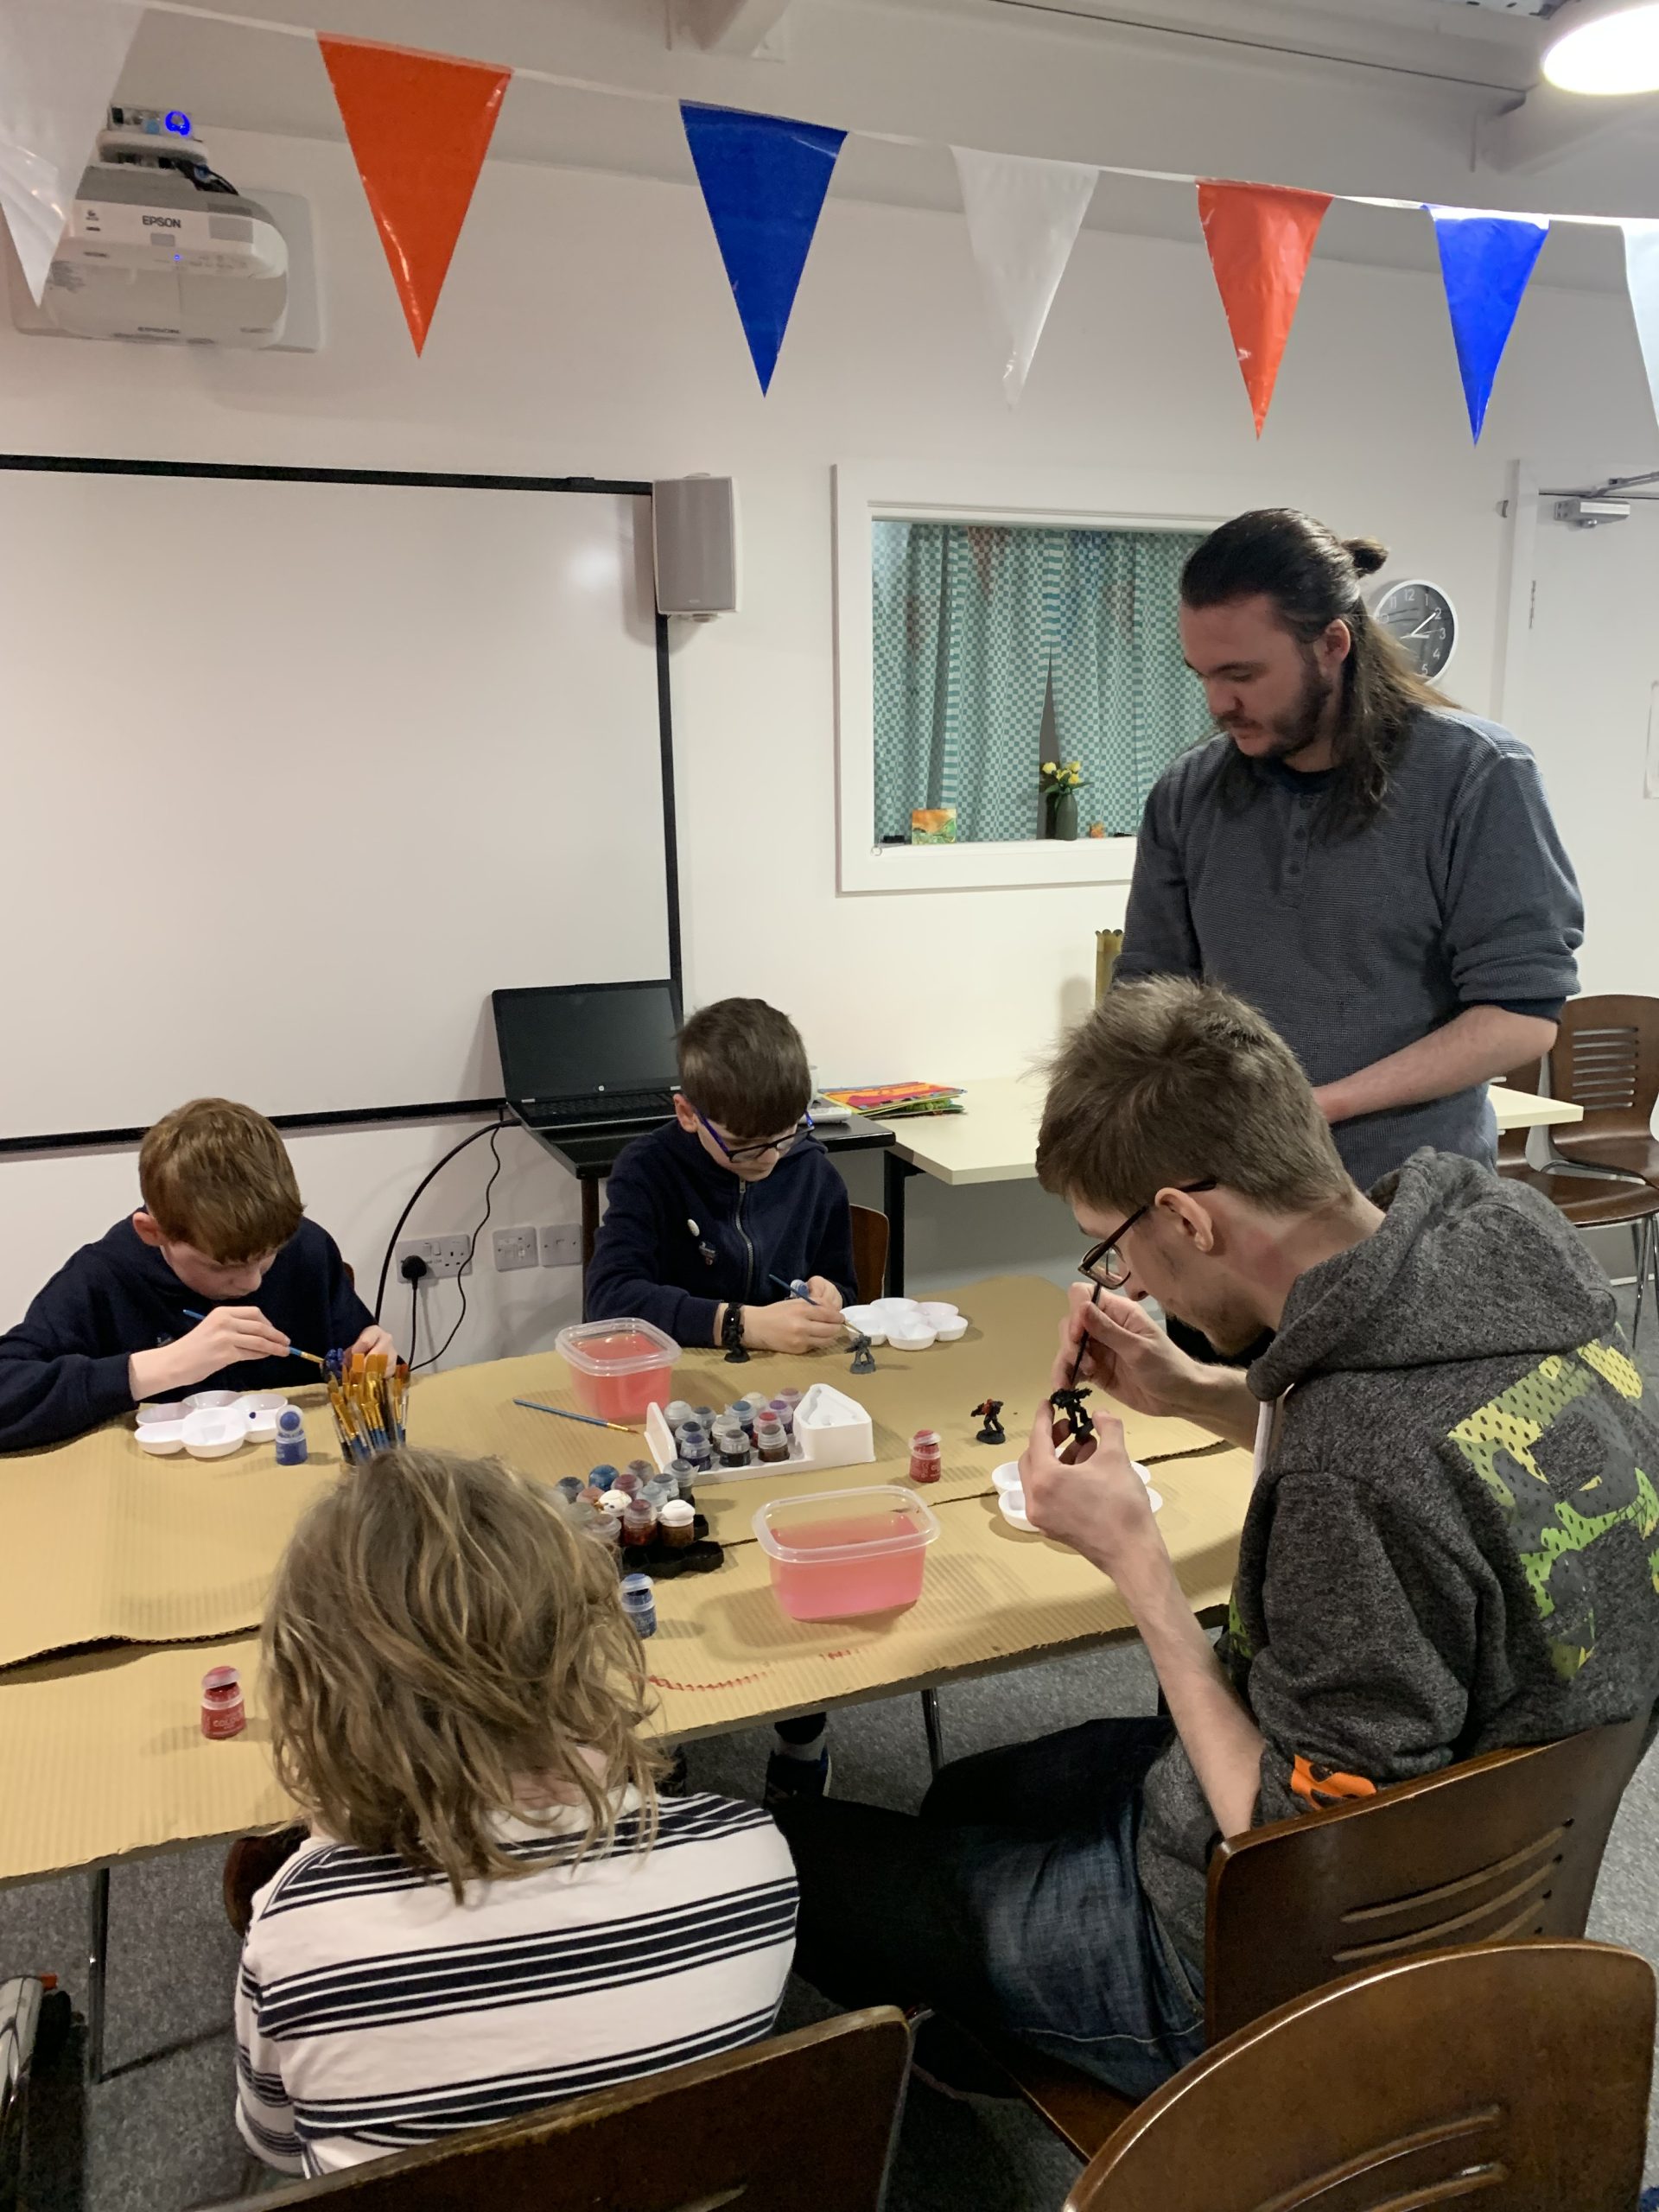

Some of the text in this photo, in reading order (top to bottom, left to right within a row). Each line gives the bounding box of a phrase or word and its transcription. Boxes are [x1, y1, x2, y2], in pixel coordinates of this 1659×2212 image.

[142, 215, 181, 228] EPSON
[1404, 588, 1415, 601] 12
[1425, 593, 1428, 607] 1
[1390, 596, 1397, 609] 11
[1434, 607, 1441, 620] 2
[1439, 627, 1446, 639] 3
[1433, 648, 1440, 659] 4
[1421, 664, 1428, 675] 5
